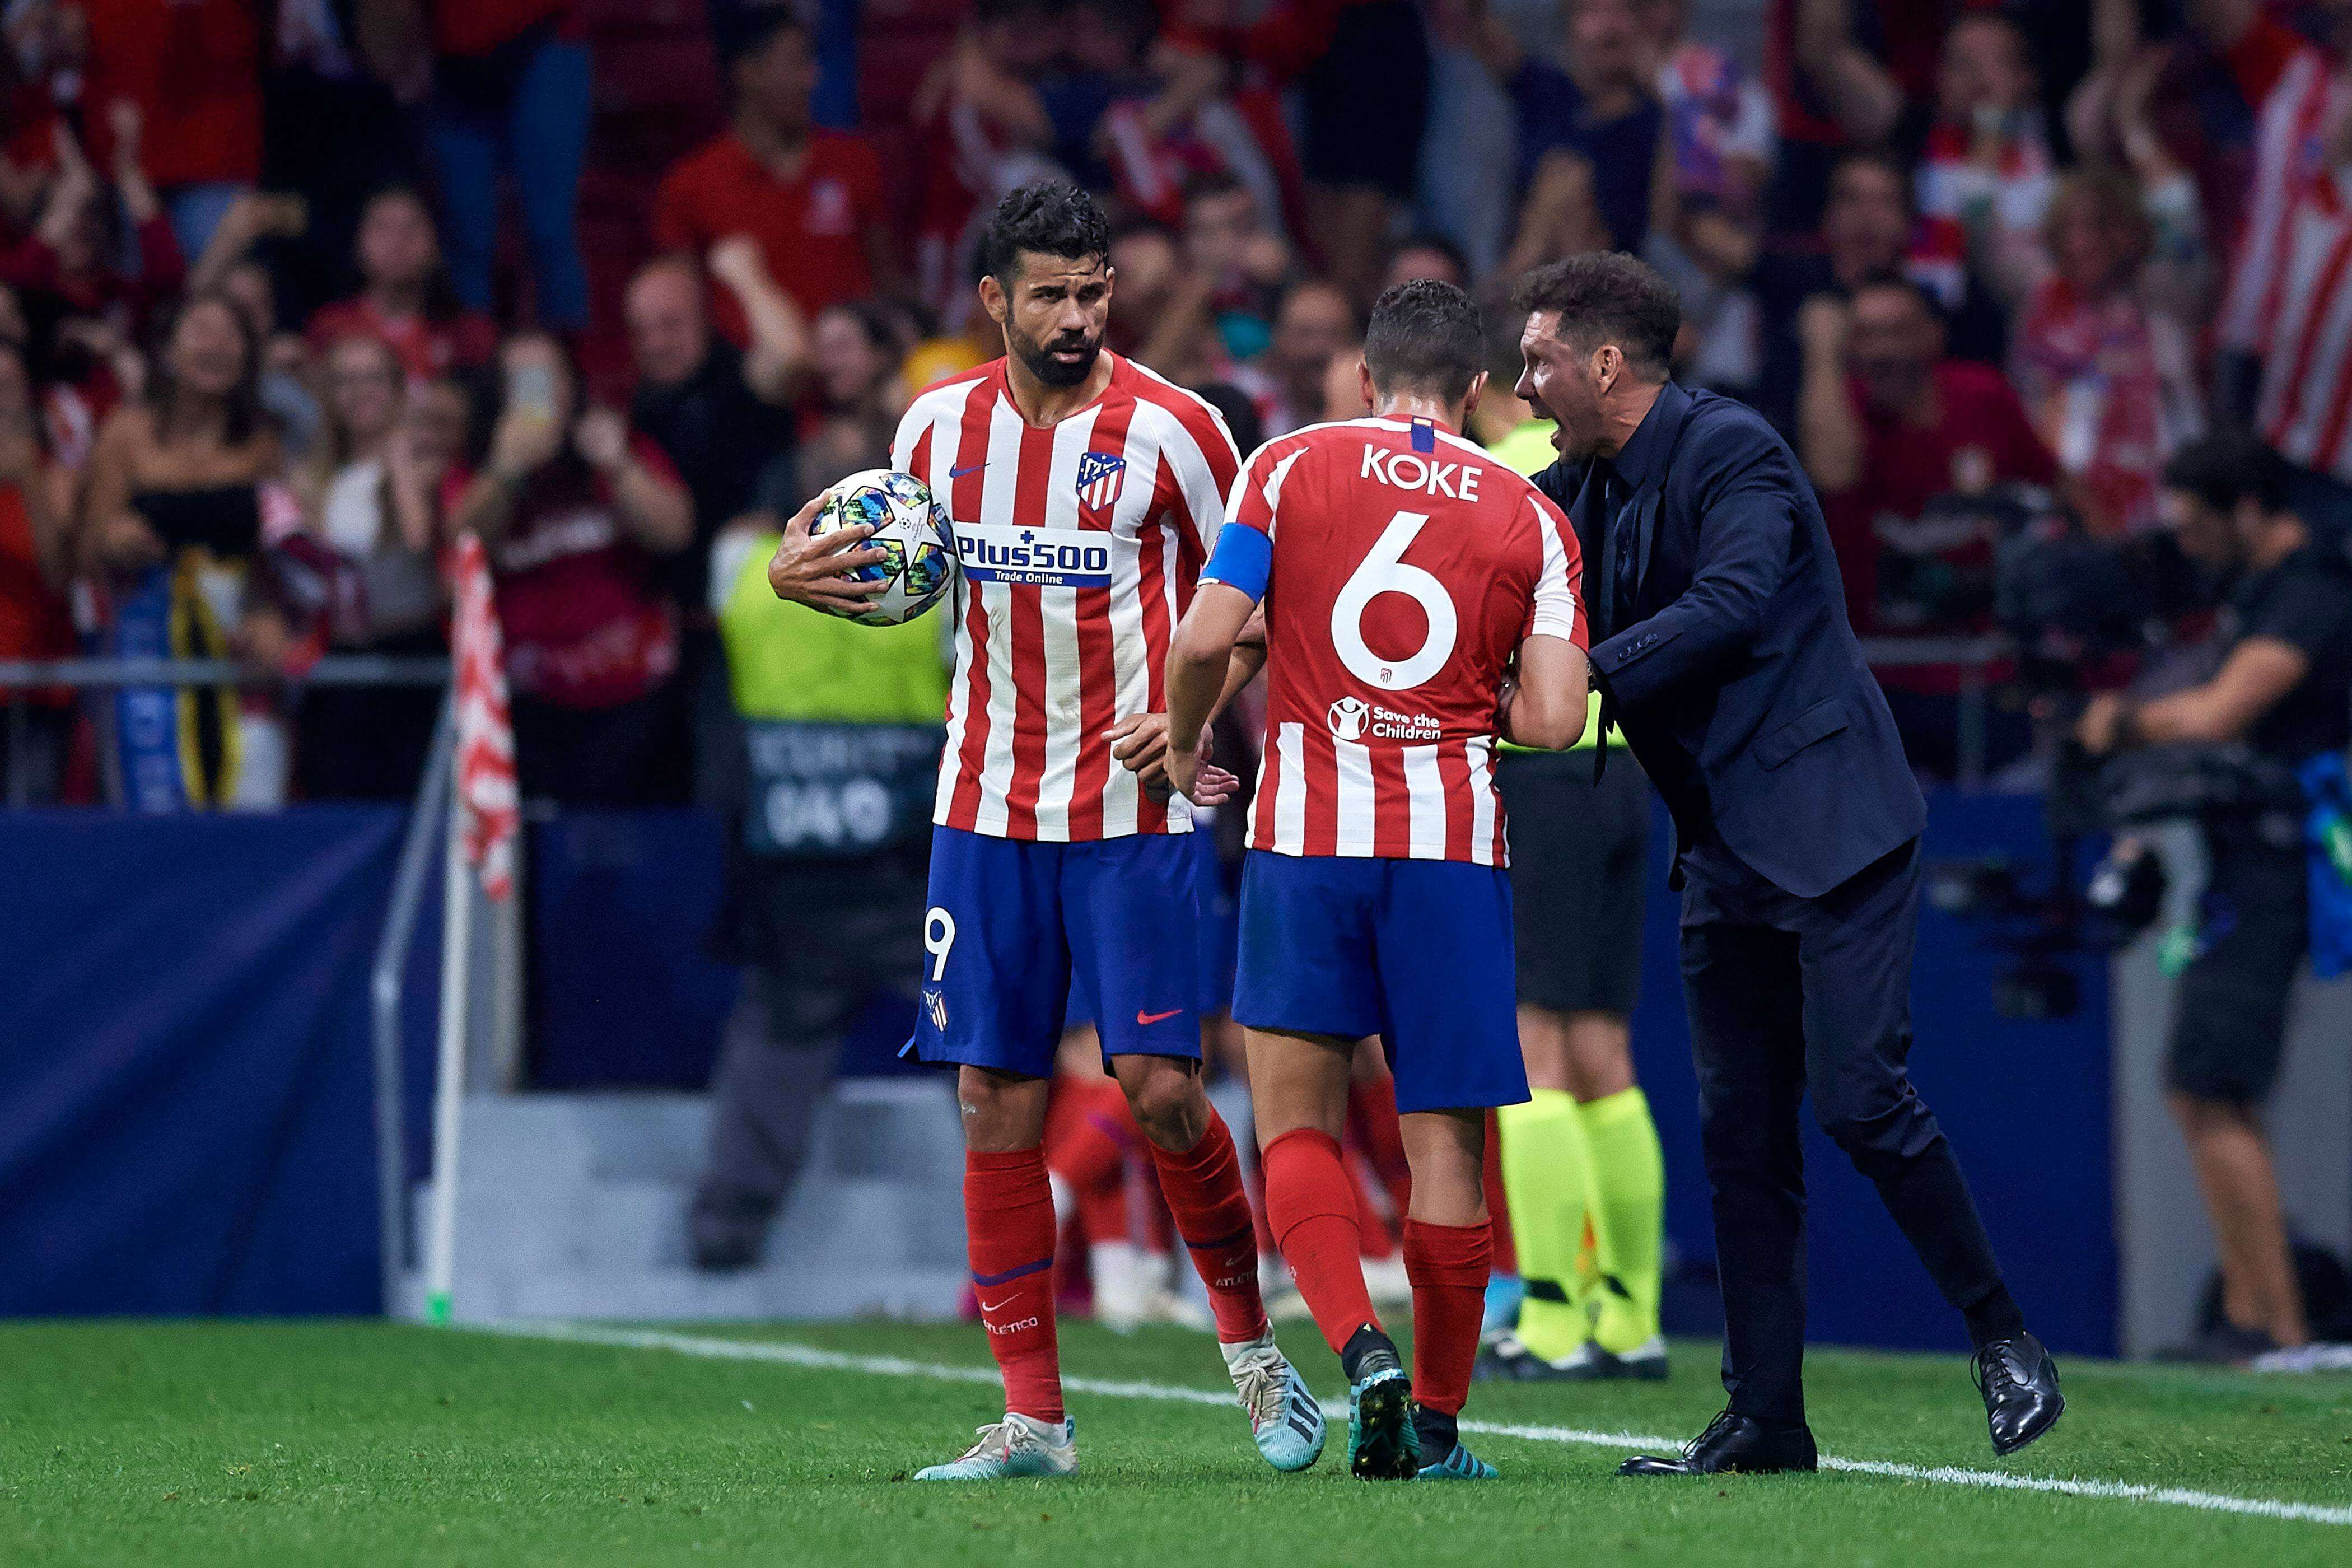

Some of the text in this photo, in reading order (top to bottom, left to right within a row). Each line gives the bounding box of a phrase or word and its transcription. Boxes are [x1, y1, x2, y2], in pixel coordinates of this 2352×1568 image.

[1361, 443, 1483, 503] KOKE
[956, 535, 1108, 571] Plus500
[995, 570, 1063, 585] Trade Online
[1331, 510, 1457, 690] 6
[1371, 725, 1441, 740] Children
[1373, 707, 1439, 728] Save the
[925, 907, 955, 981] 9
